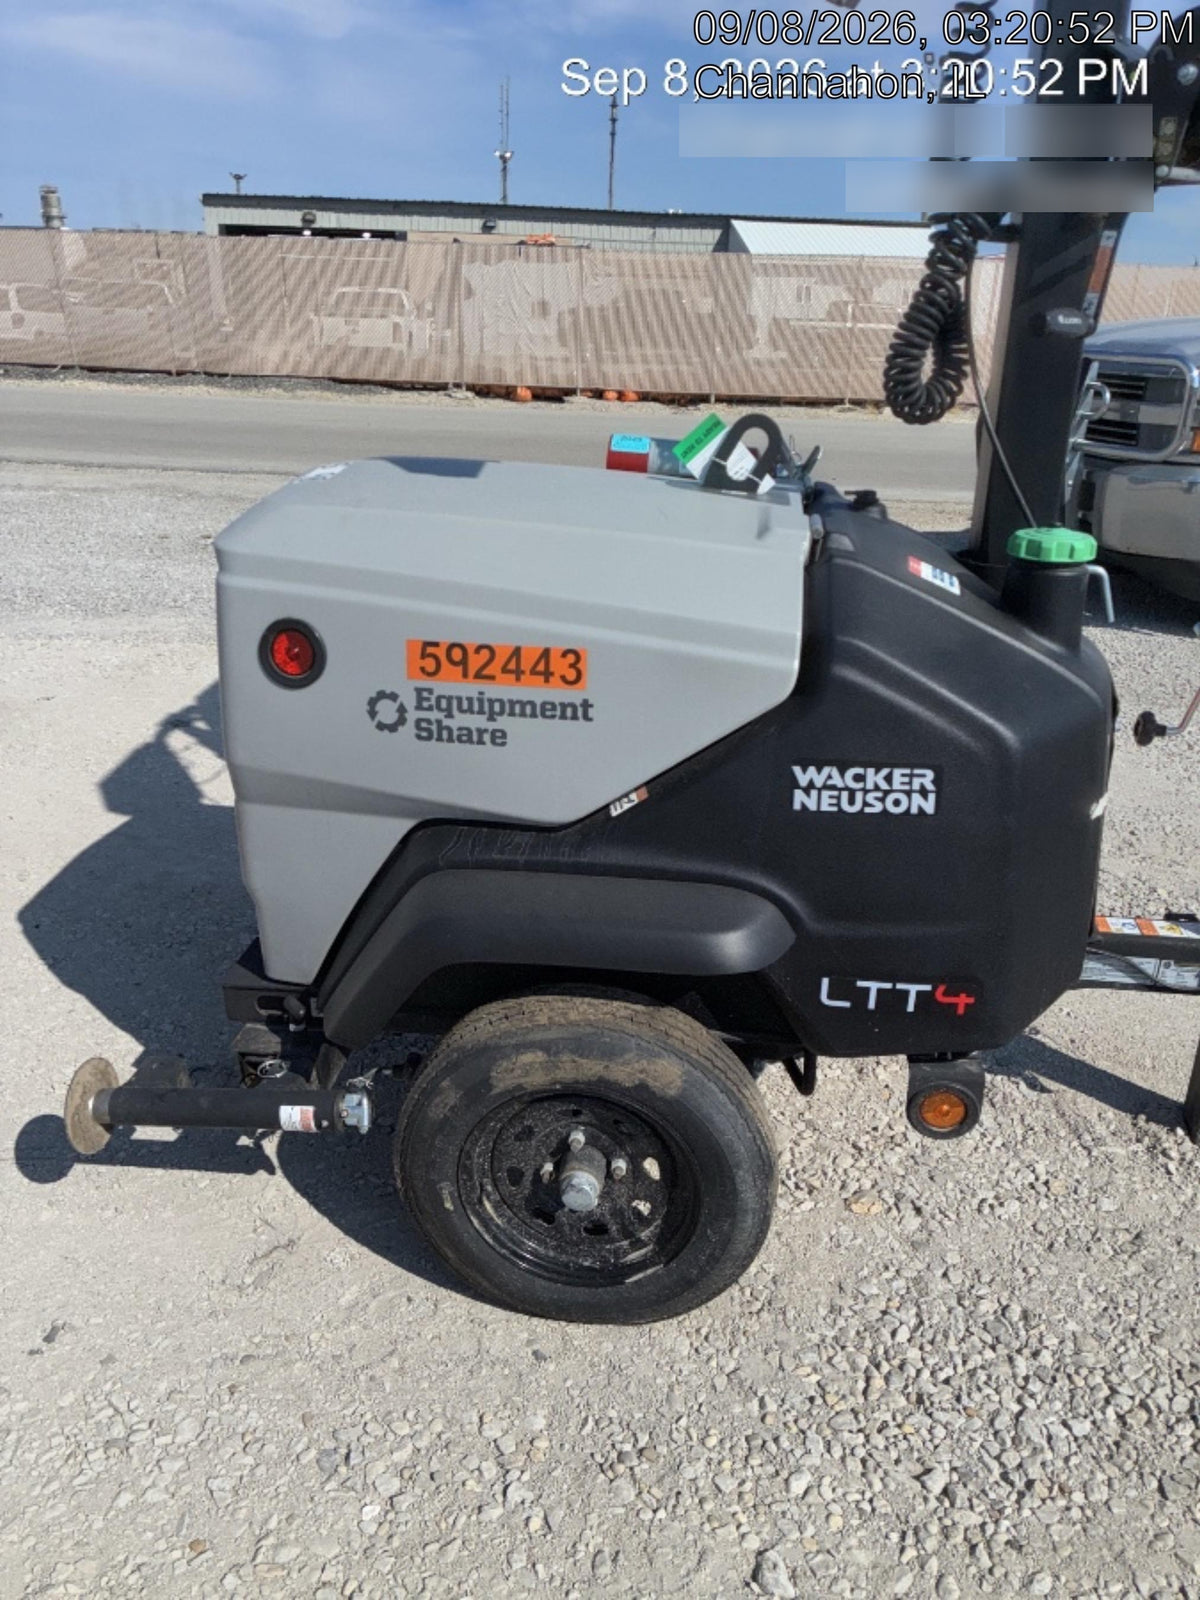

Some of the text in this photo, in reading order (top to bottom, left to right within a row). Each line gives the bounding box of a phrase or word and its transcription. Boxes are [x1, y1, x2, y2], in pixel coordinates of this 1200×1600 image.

[418, 641, 583, 686] 592443
[413, 687, 594, 722] Equipment
[414, 717, 508, 747] Share
[791, 765, 937, 791] WACKER
[792, 789, 937, 815] NEUSON
[819, 977, 976, 1015] LTT4
